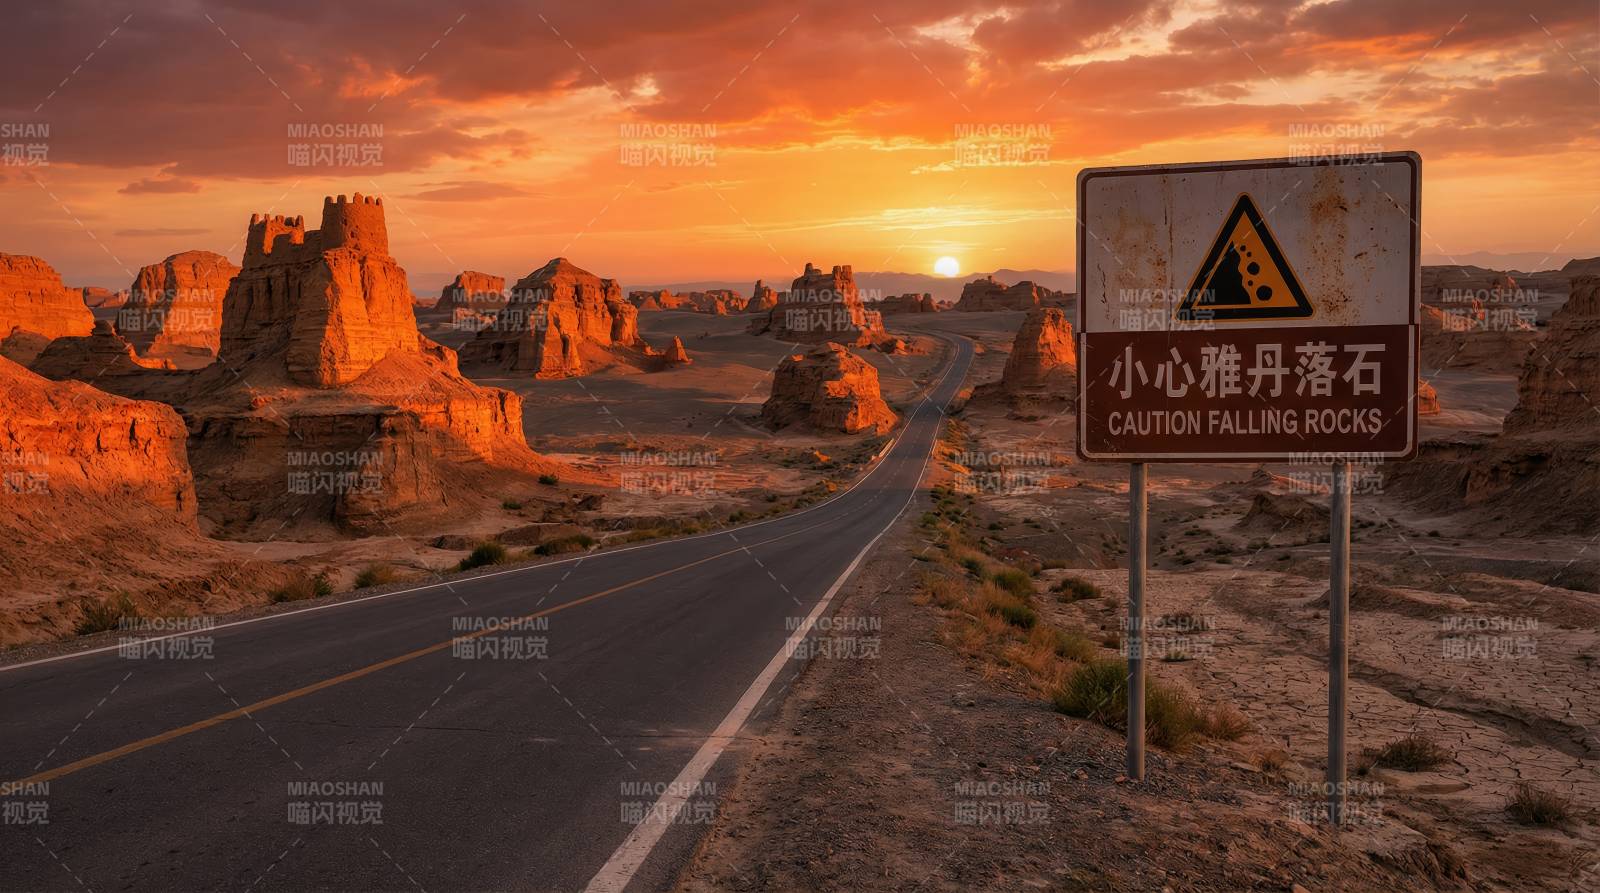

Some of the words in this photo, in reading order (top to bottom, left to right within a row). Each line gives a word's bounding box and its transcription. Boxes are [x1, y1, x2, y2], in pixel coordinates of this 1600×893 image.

[1108, 341, 1385, 399] 小心雅丹落石
[1108, 410, 1201, 435] CAUTION
[1208, 409, 1298, 435] FALLING
[1305, 408, 1383, 434] ROCKS
